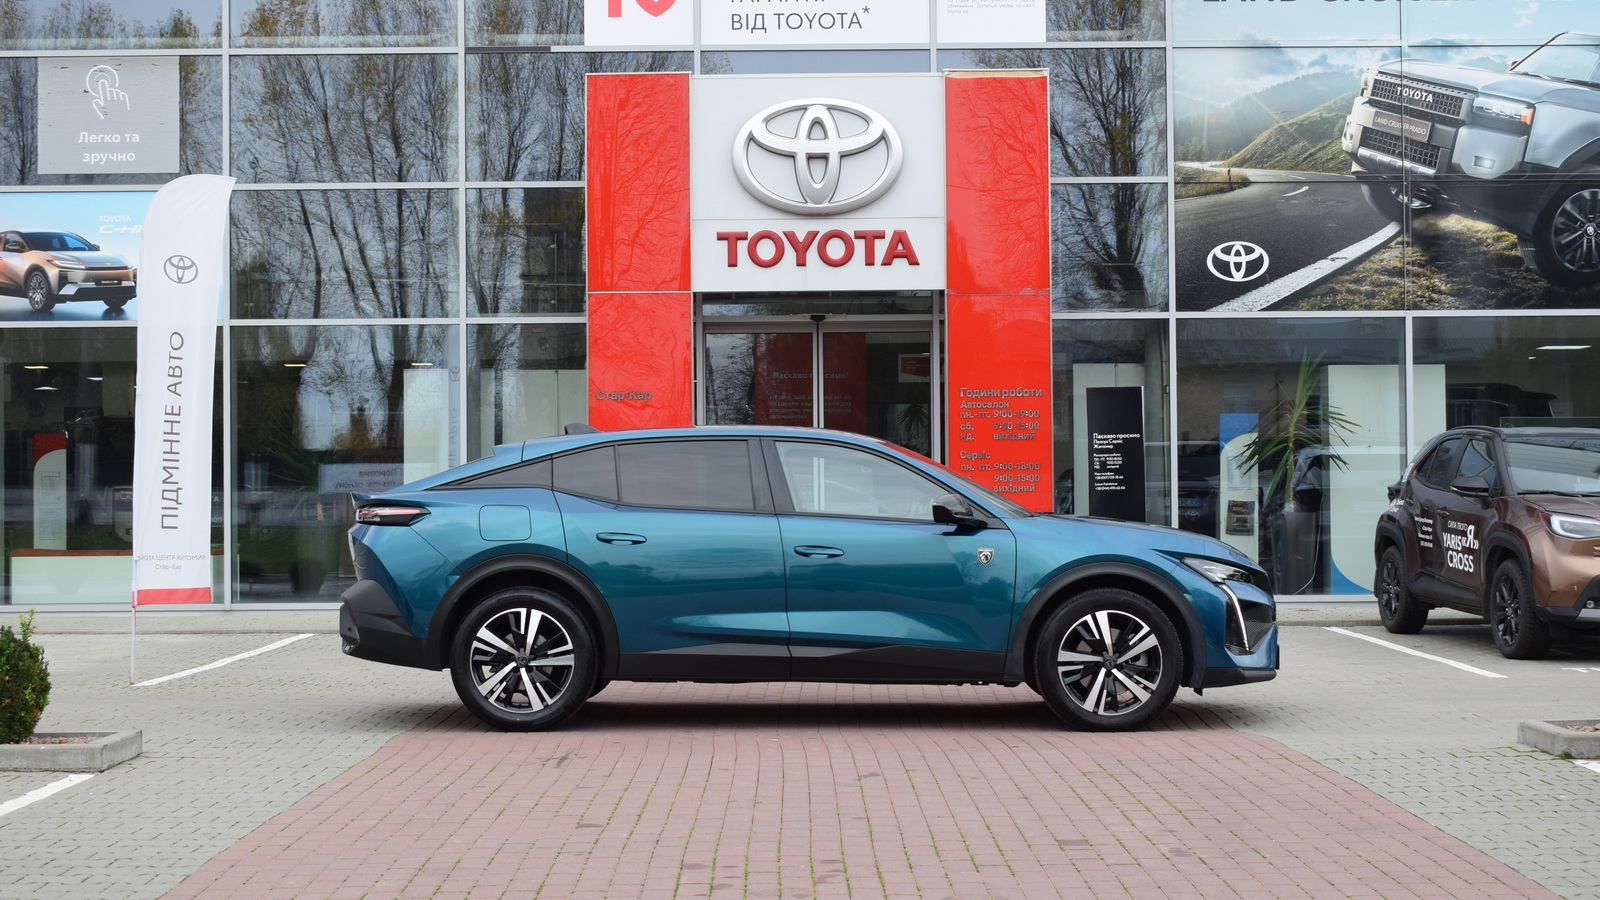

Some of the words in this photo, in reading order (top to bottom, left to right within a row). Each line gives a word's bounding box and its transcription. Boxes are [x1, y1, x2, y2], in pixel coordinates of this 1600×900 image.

[731, 13, 767, 34] ВІД
[1397, 87, 1433, 103] TOYOTA
[1374, 116, 1388, 125] LAND
[1410, 126, 1427, 135] PRADO
[78, 131, 121, 143] Легко
[124, 133, 140, 142] та
[82, 152, 136, 164] зручно
[716, 229, 920, 268] TOYOTA
[167, 332, 184, 397] АВТО
[596, 390, 652, 402] Стар-Кар
[960, 388, 1000, 398] Години
[1002, 387, 1042, 399] роботи
[960, 401, 1010, 409] Автосалон
[960, 422, 974, 430] сб.
[993, 432, 1035, 440] вихідний
[960, 451, 990, 460] Сервіс
[161, 404, 183, 529] ПІДМІННЕ
[994, 484, 1035, 492] вихідний
[1442, 532, 1462, 551] YARIS
[1448, 550, 1474, 573] CROSS
